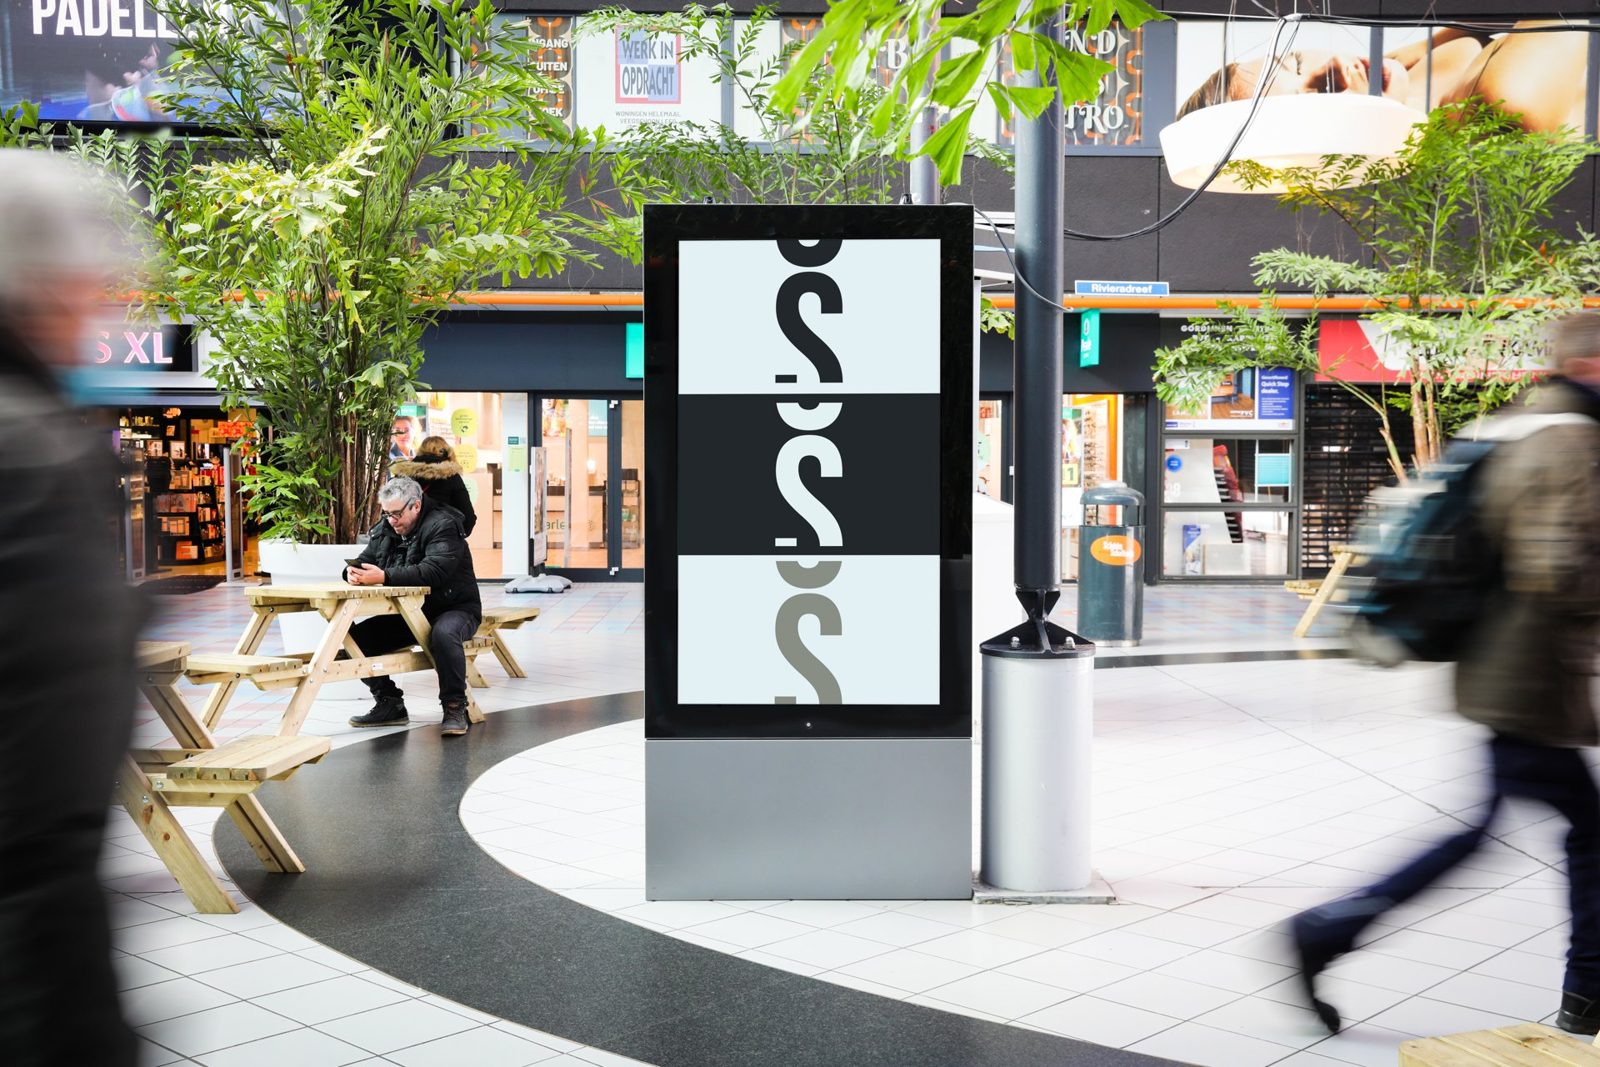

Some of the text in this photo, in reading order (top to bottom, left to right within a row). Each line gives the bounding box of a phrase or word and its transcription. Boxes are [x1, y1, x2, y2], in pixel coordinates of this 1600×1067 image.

[32, 0, 212, 39] PADELL
[622, 40, 674, 60] WERK IN
[622, 66, 675, 96] OPDRACHT
[1091, 283, 1153, 294] Rivieradreef
[123, 331, 173, 364] XL
